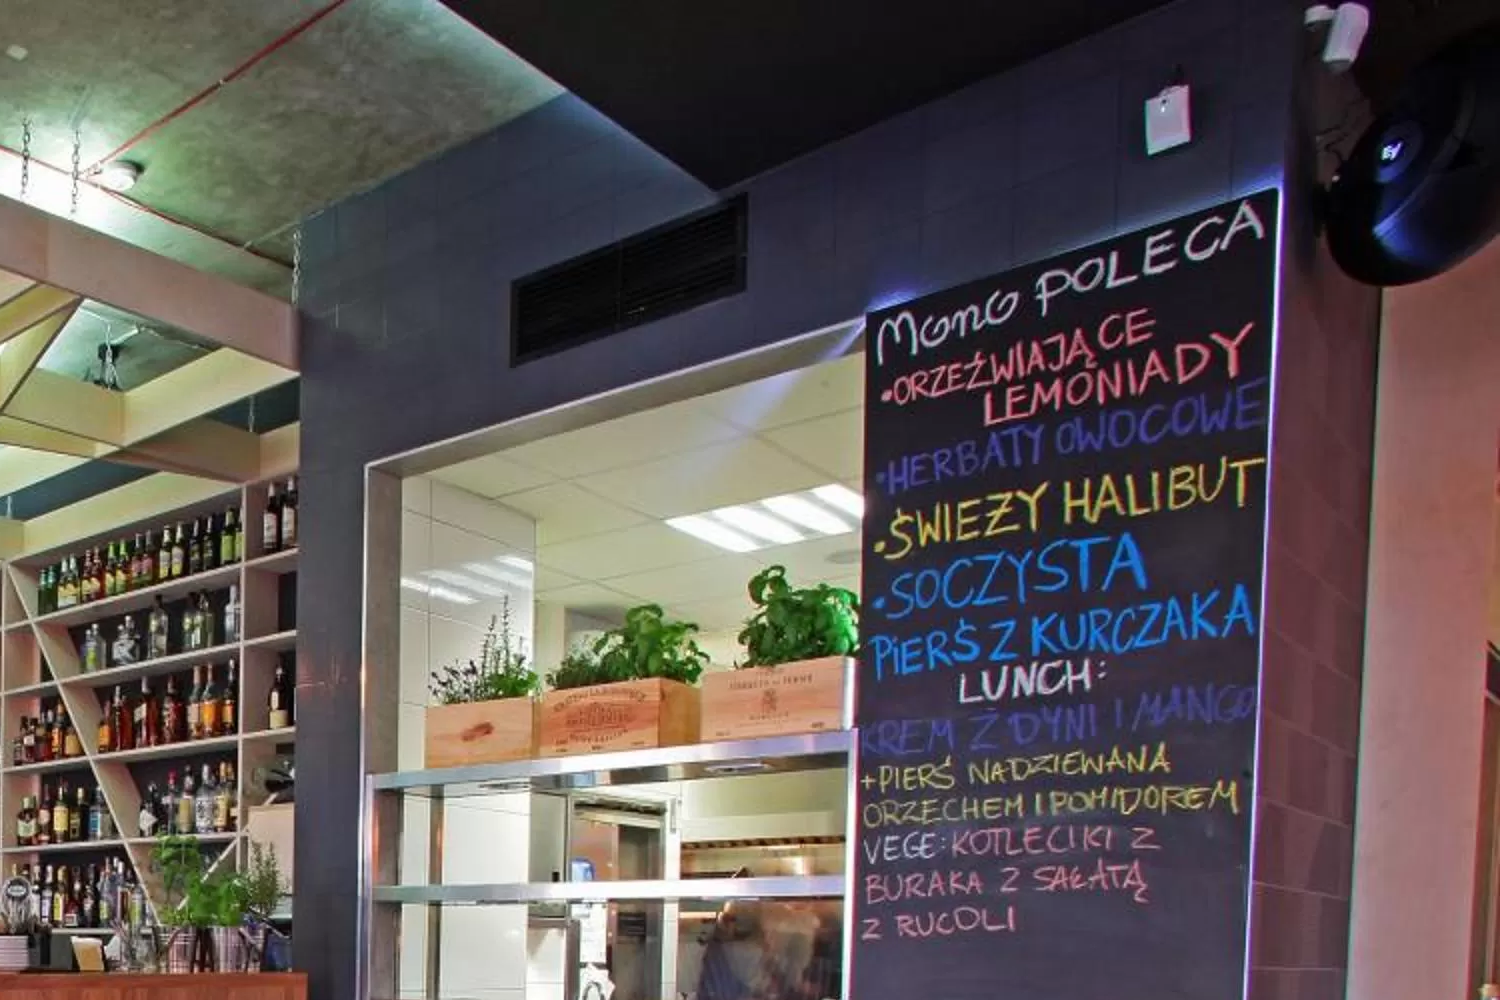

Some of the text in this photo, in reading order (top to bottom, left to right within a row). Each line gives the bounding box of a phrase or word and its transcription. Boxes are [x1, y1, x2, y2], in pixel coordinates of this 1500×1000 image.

[1035, 198, 1265, 318] POLECA
[984, 321, 1255, 427] LEMONIADY
[887, 376, 1269, 495] HERBATY OWOCOWE
[1063, 454, 1267, 525] HALIBUT
[886, 531, 1148, 619] SOCZYSTA
[988, 619, 1019, 661] Z
[1031, 583, 1256, 657] KURCZAKA
[860, 719, 955, 755] KREM
[1006, 703, 1097, 745] DYNI
[1131, 682, 1257, 732] MANGO
[968, 741, 1172, 785] NADZIEWANA
[863, 793, 1025, 828] ORZECHEM
[1050, 779, 1239, 816] POMIDOREM
[952, 824, 1113, 857] KOTLECIKI
[865, 870, 984, 905] BURAKA
[895, 905, 1016, 938] RUCOLI
